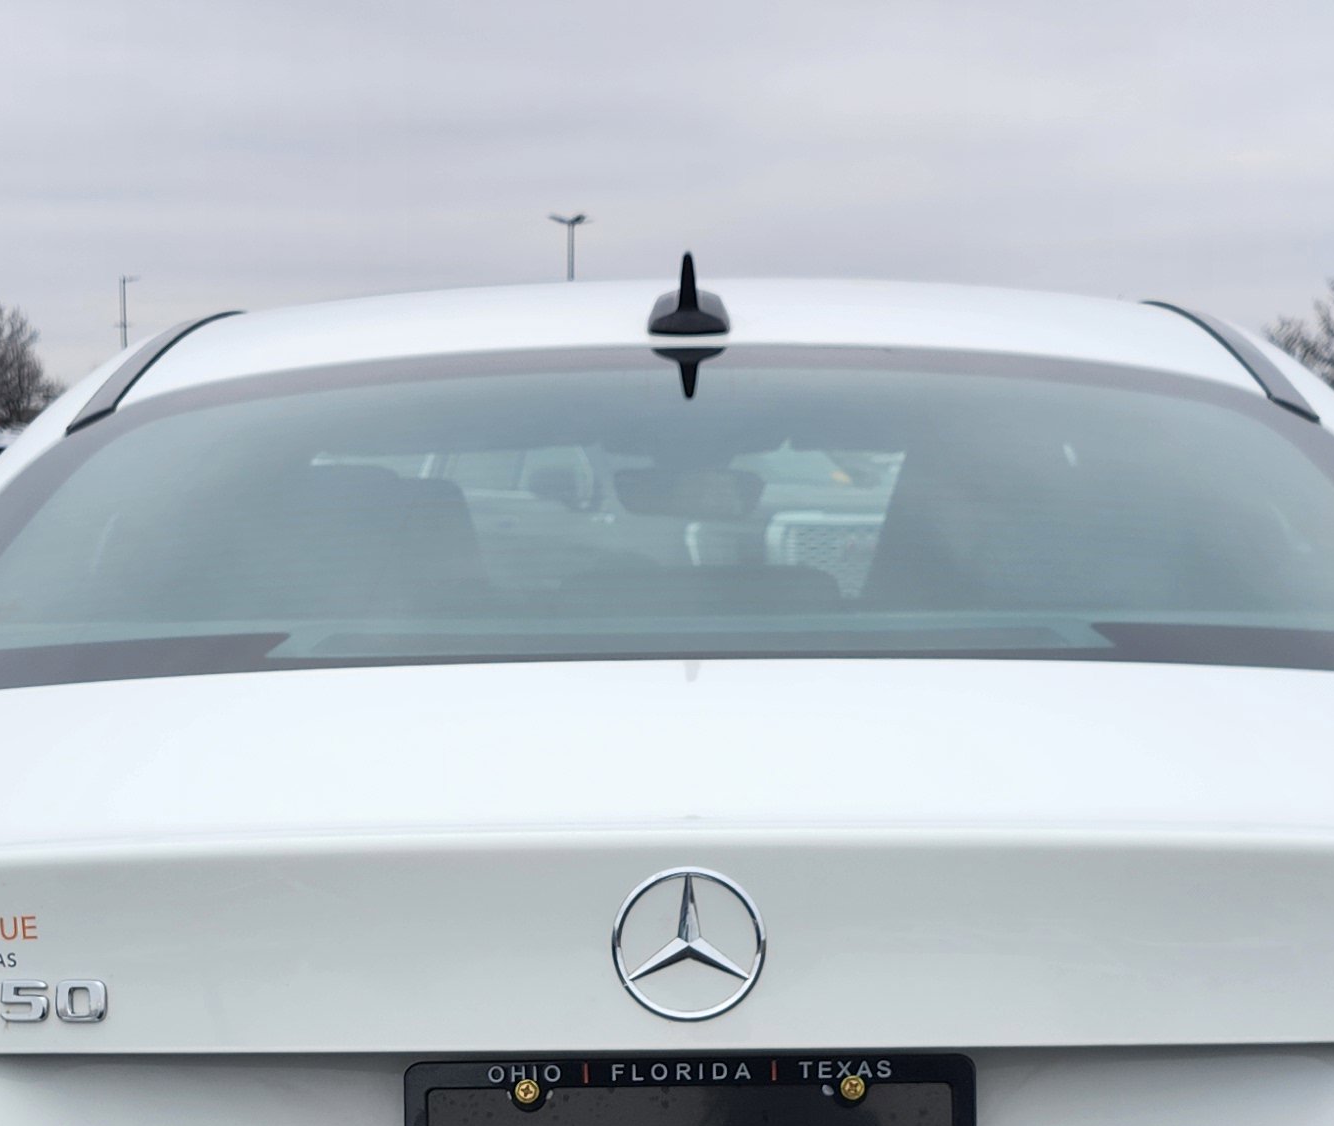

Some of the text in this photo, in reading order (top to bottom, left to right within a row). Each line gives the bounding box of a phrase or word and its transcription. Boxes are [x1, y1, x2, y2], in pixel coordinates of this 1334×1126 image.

[488, 1060, 892, 1083] OHIO FLORIDA TEXAS
